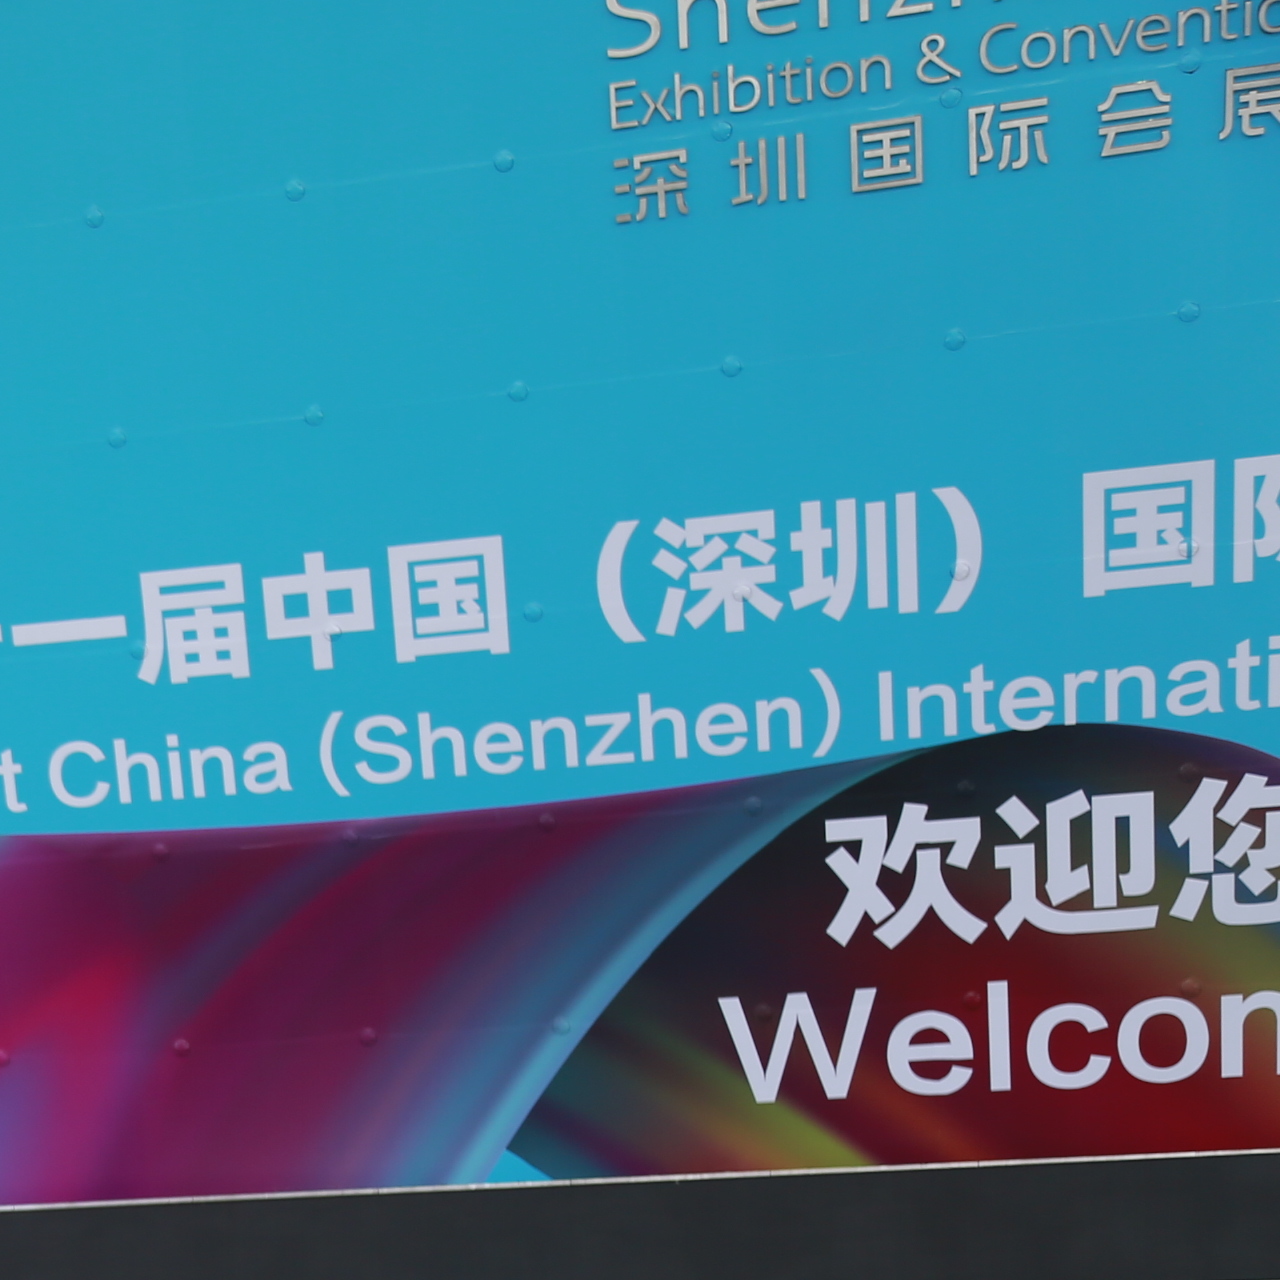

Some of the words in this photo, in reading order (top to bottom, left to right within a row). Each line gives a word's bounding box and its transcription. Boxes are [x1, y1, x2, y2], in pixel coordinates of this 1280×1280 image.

[608, 53, 892, 131] Exhibition
[916, 33, 961, 85] &
[48, 734, 292, 808] China
[318, 668, 842, 798] (Shenzhen)
[824, 771, 1280, 950] 欢迎您
